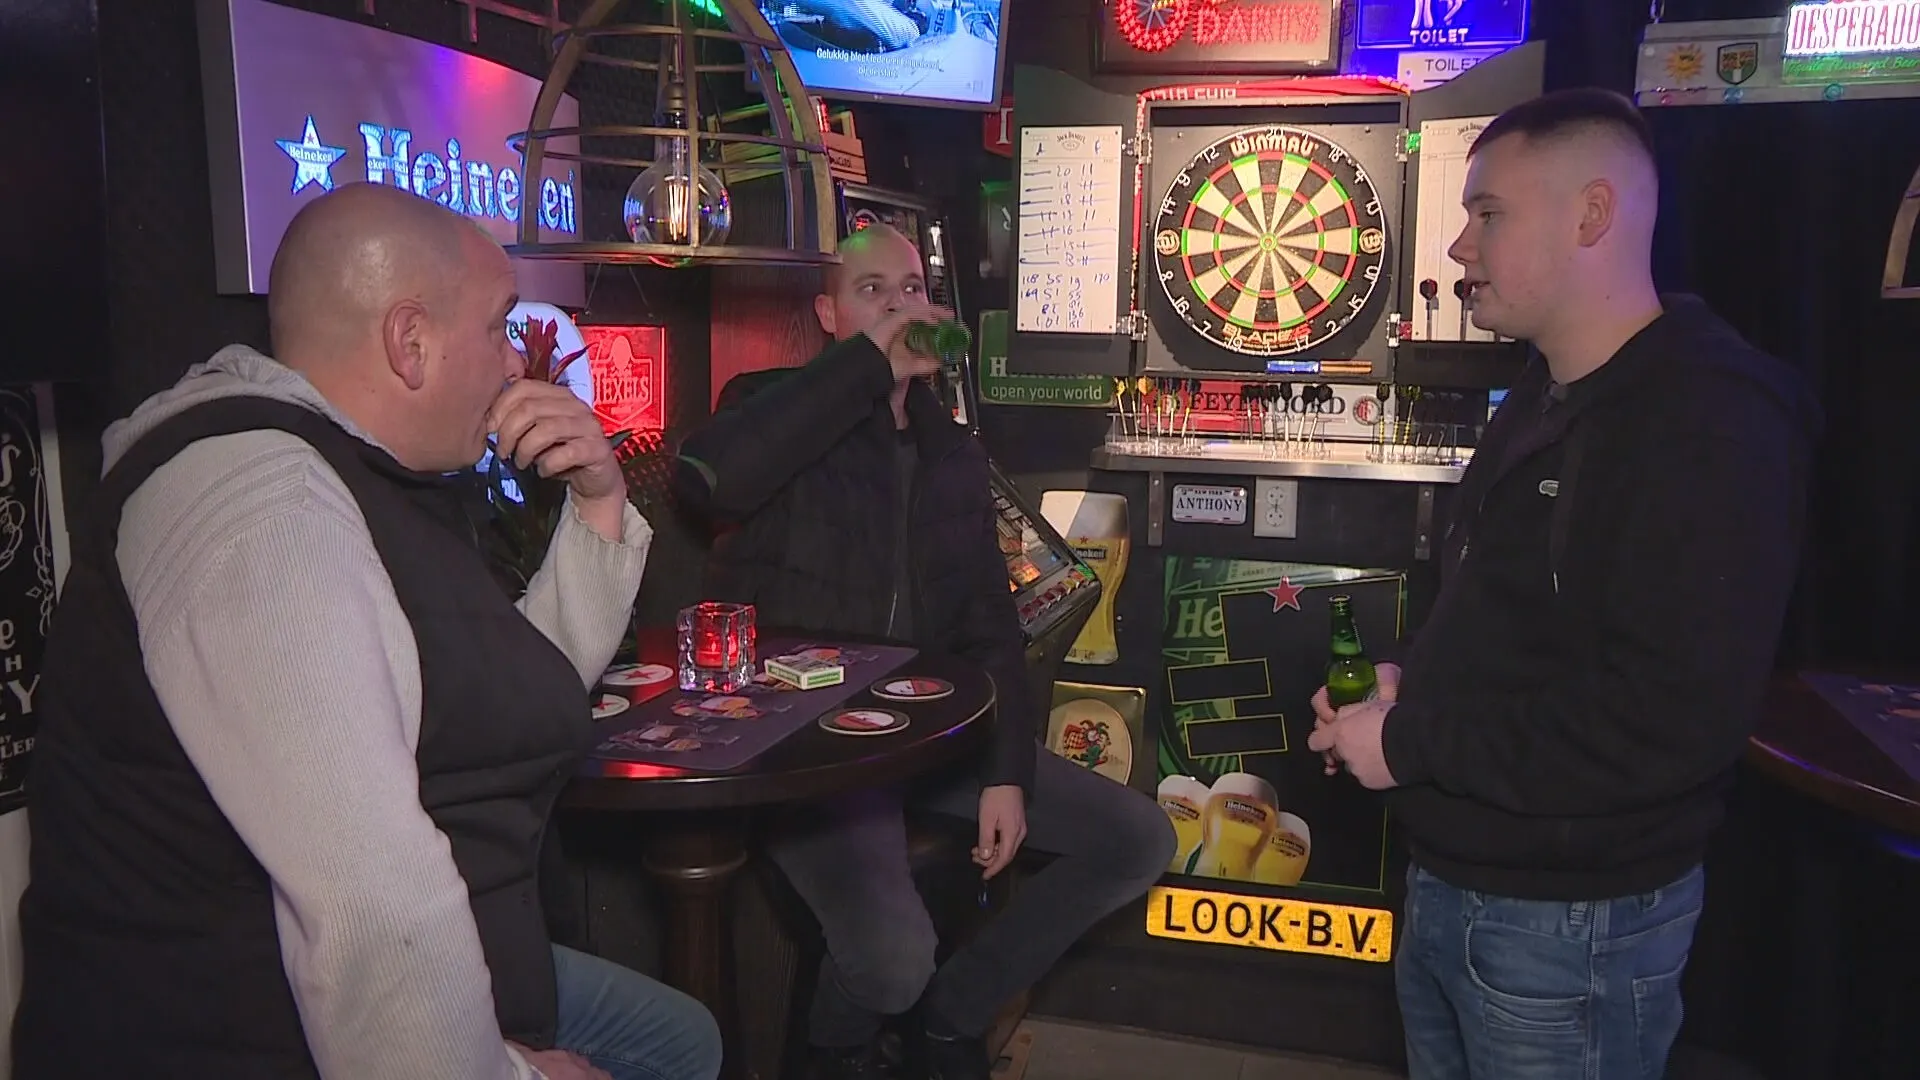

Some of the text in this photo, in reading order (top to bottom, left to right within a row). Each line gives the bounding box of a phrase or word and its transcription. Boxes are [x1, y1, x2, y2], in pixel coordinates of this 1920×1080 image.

[1192, 5, 1319, 45] DARTS
[1410, 28, 1469, 44] TOILET
[816, 47, 849, 62] Gelukkig
[1229, 133, 1316, 157] WINMAU
[289, 146, 334, 163] Heineken
[1201, 147, 1220, 164] 12
[1328, 145, 1345, 163] 18
[359, 122, 577, 234] Heineen
[1060, 194, 1071, 205] 18
[1062, 225, 1073, 235] 16
[1200, 320, 1212, 335] 7
[1326, 319, 1337, 333] 2
[591, 367, 649, 404] TEXELS
[991, 384, 1102, 401] open your world
[1176, 498, 1242, 512] ANTHONY
